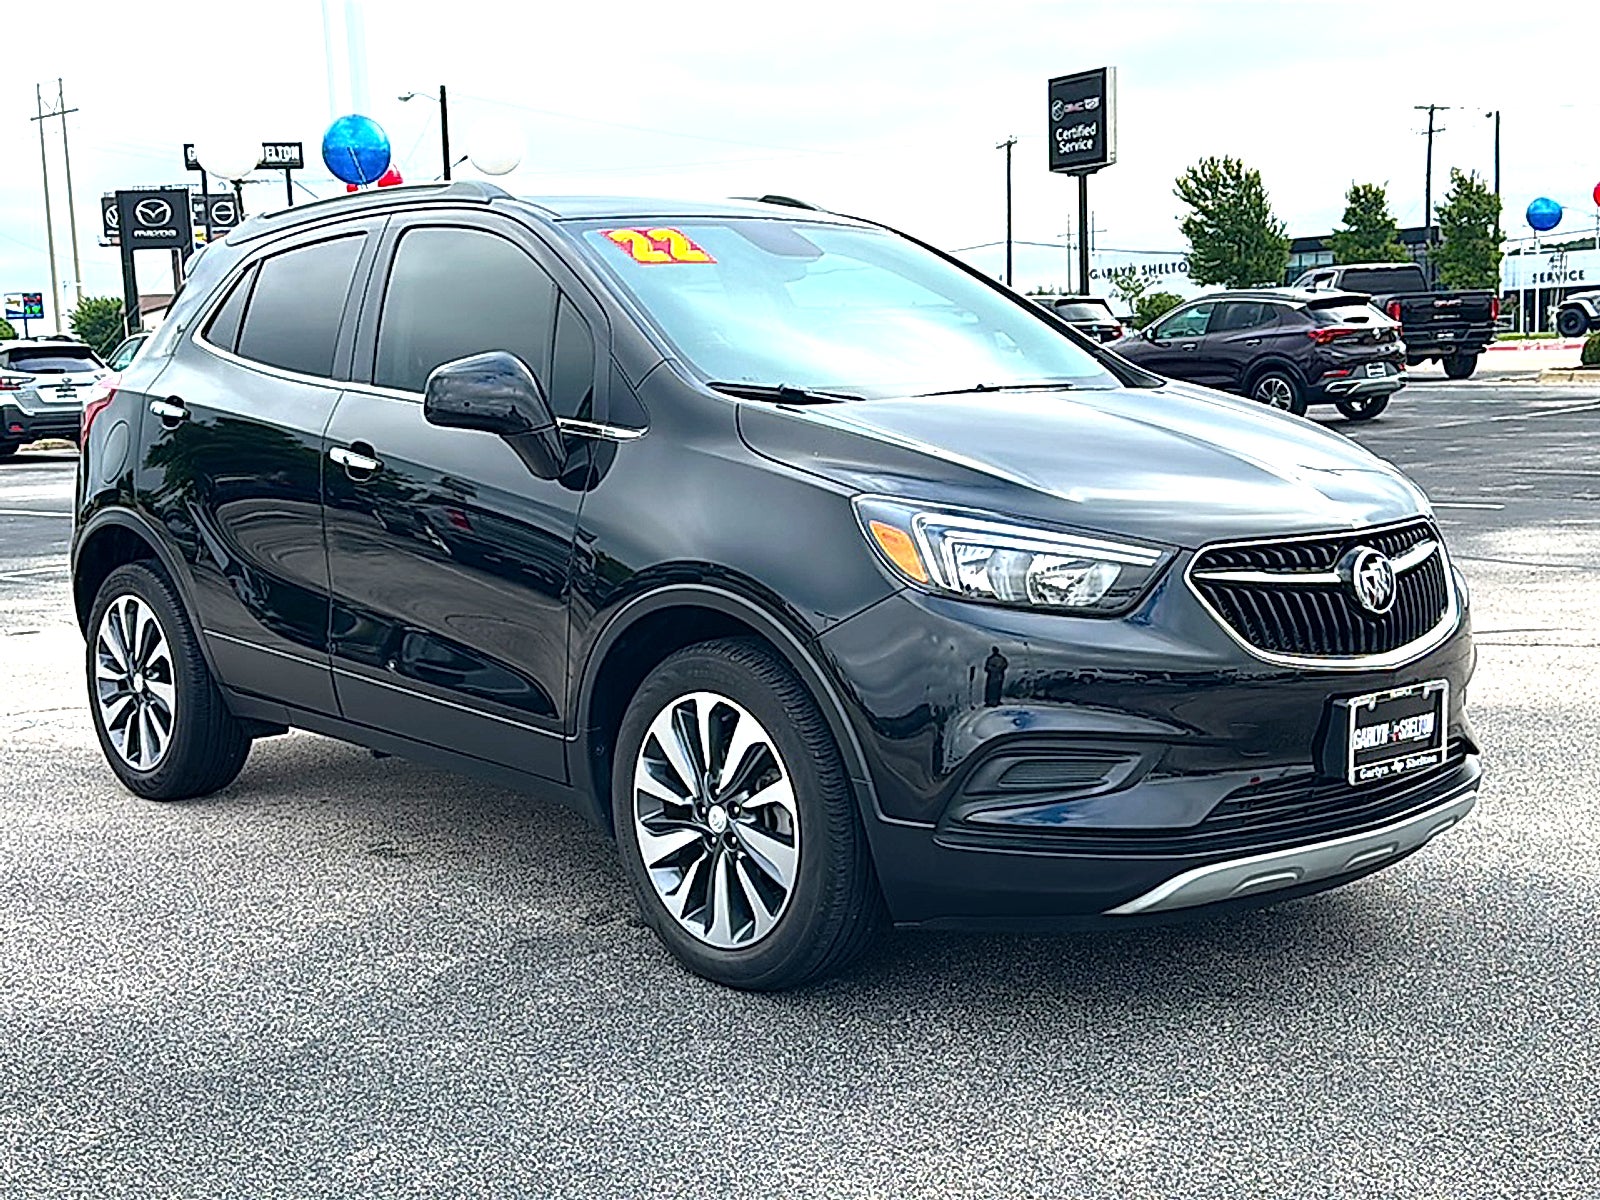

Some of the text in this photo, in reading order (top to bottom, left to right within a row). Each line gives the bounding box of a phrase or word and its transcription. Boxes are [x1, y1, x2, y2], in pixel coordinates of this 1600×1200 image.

[1056, 121, 1097, 141] Certified
[1059, 138, 1093, 154] Service
[133, 229, 177, 238] mazda
[607, 229, 710, 262] 22
[1141, 262, 1188, 276] SHELTO
[1532, 269, 1585, 284] SERVICE
